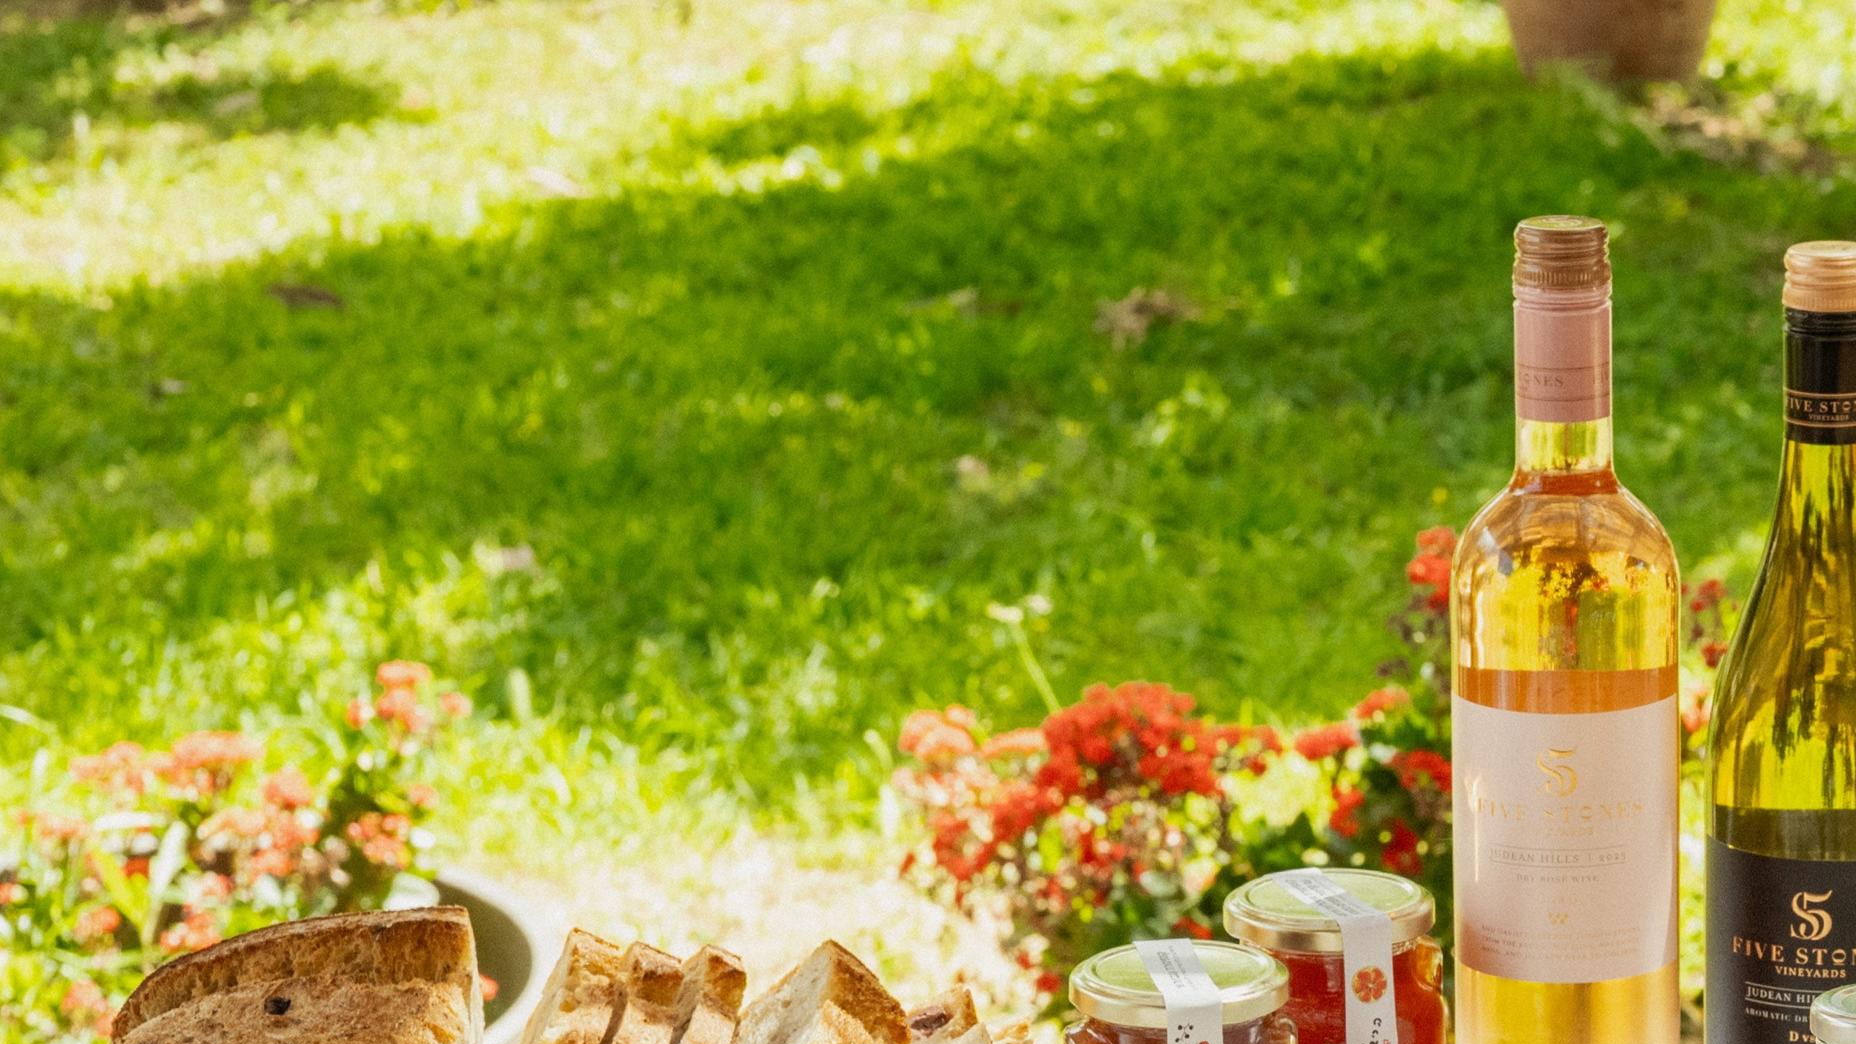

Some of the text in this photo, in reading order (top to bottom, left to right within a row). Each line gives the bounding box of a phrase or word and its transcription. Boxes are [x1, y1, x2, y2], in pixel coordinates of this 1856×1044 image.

[1477, 798, 1524, 821] FIVE
[1540, 854, 1579, 865] HILLS
[1732, 935, 1784, 963] FIVE
[1775, 965, 1847, 978] VINEYARDS
[1746, 986, 1791, 1002] JUDEAN
[1745, 1007, 1808, 1023] AROMATIC DR
[1789, 1030, 1799, 1042] D
